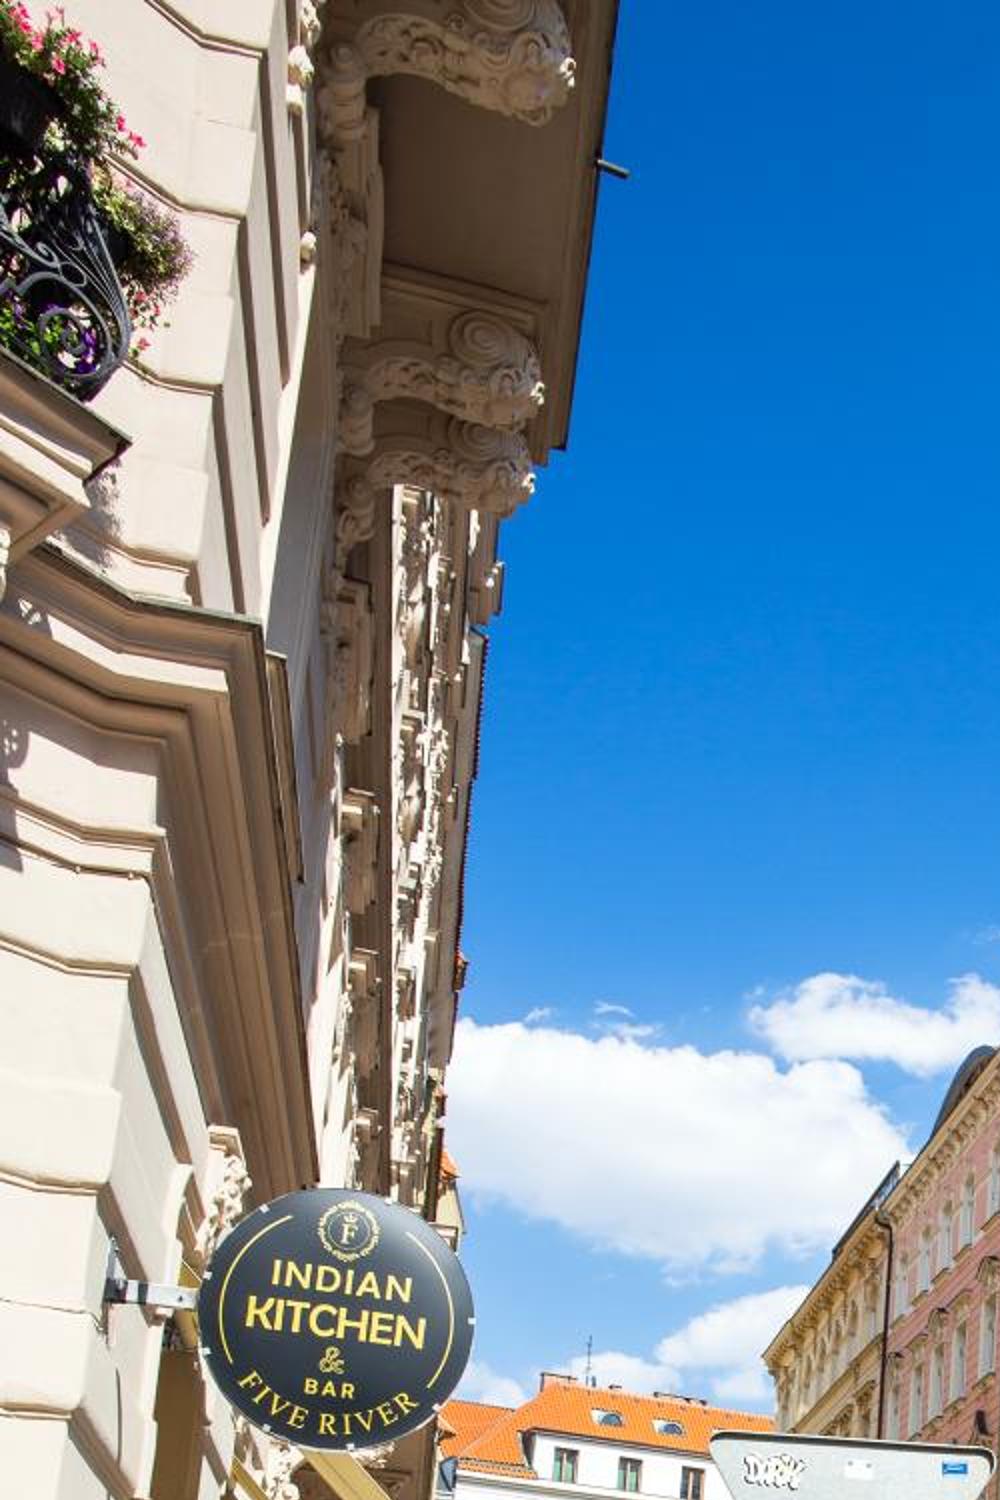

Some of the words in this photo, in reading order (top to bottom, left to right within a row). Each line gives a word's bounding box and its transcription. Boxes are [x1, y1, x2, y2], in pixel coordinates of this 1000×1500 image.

[271, 1259, 413, 1303] INDIAN
[245, 1295, 427, 1351] KITCHEN
[318, 1346, 345, 1375] &
[237, 1369, 309, 1430] FIVE
[318, 1391, 420, 1435] RIVER
[304, 1378, 355, 1399] BAR
